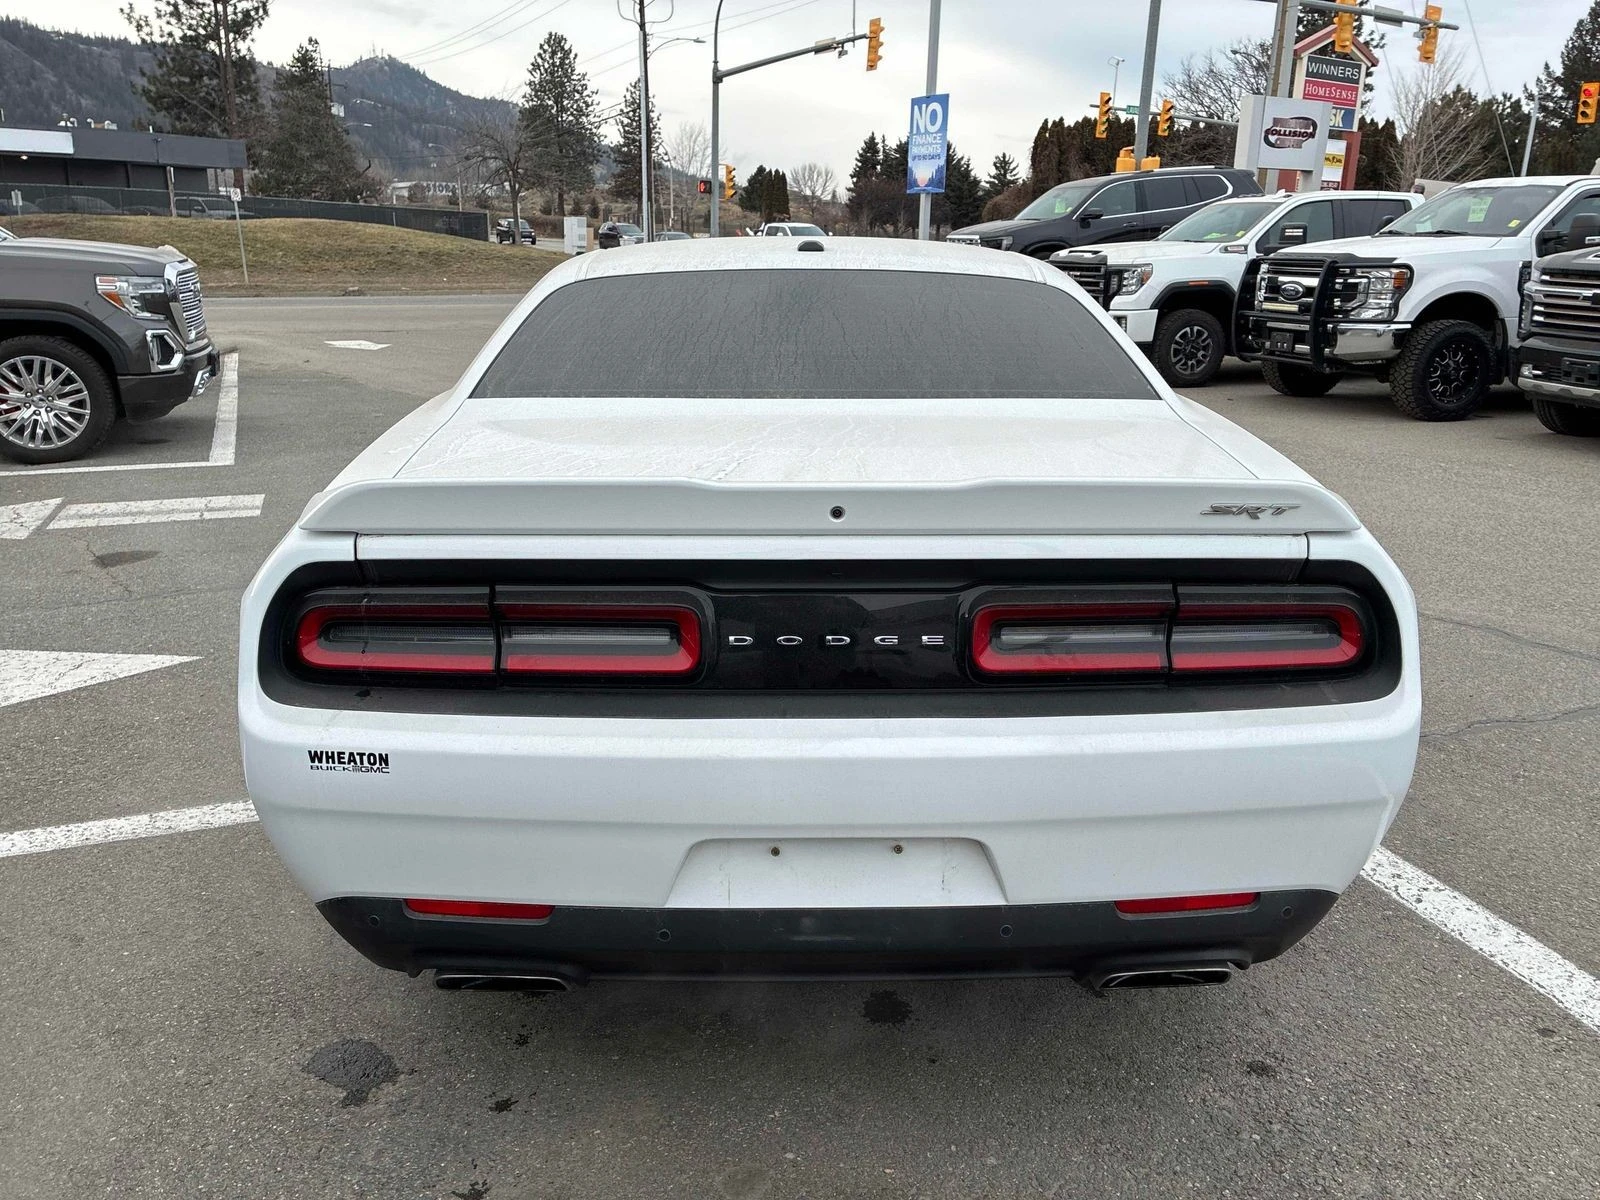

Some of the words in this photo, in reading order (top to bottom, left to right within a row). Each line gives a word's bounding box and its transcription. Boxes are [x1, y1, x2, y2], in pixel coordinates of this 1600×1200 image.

[1308, 62, 1360, 79] WINNERS
[913, 102, 943, 134] NO
[912, 133, 942, 144] FINANCE
[1264, 128, 1316, 139] COLLISION
[1200, 502, 1301, 520] SRT
[728, 635, 945, 646] DODGE
[307, 750, 390, 766] WHEATON
[360, 766, 390, 774] GMC
